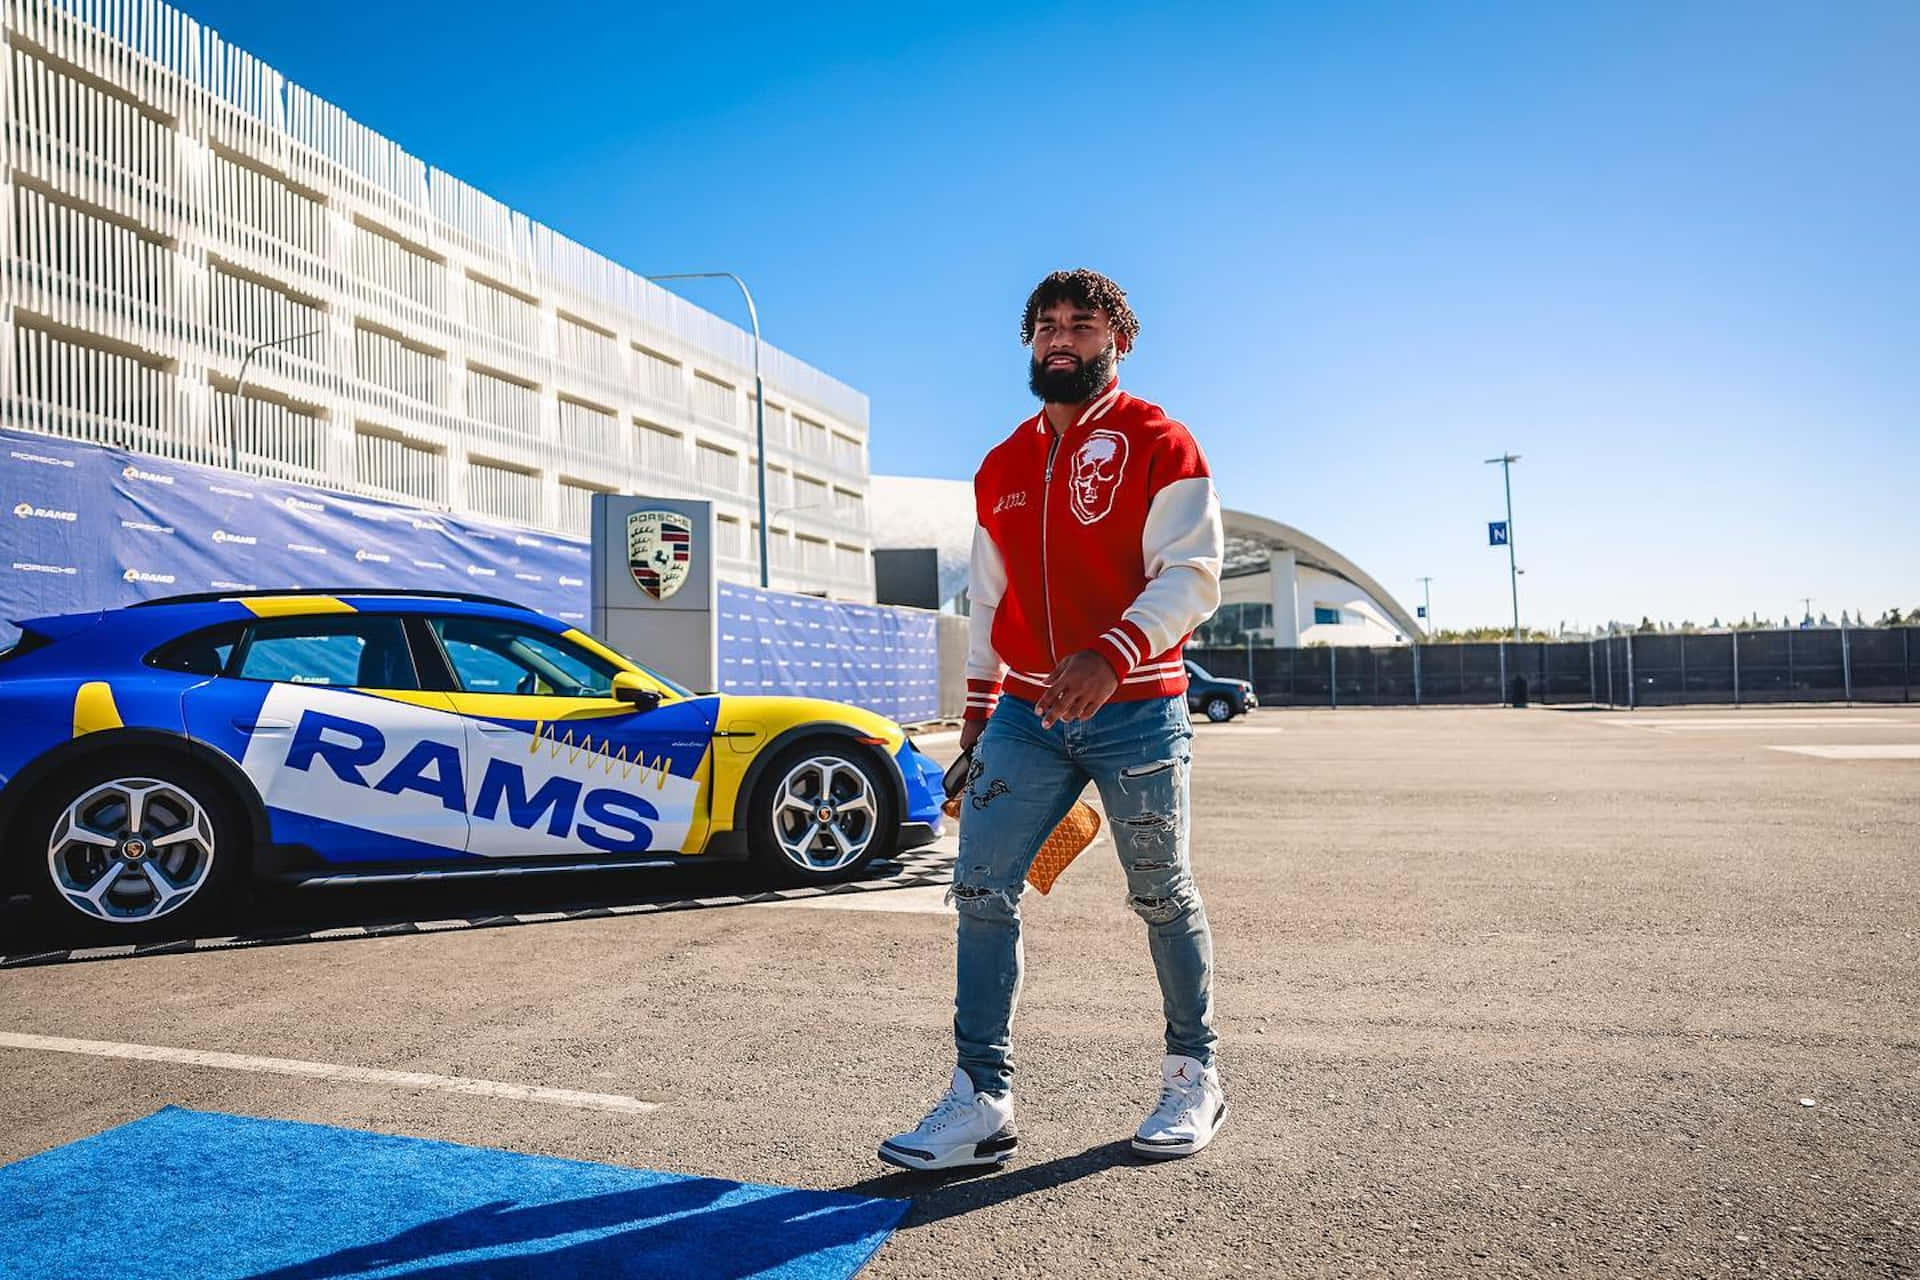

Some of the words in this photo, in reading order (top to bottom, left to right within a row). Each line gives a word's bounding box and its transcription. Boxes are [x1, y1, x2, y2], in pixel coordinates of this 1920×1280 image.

[139, 471, 174, 485] RAMS
[34, 508, 77, 521] RAMS
[630, 513, 689, 529] PORSCHE
[1494, 528, 1505, 542] N
[13, 562, 77, 575] PORSCHE
[140, 572, 175, 584] RAMS
[285, 708, 660, 854] RAMS
